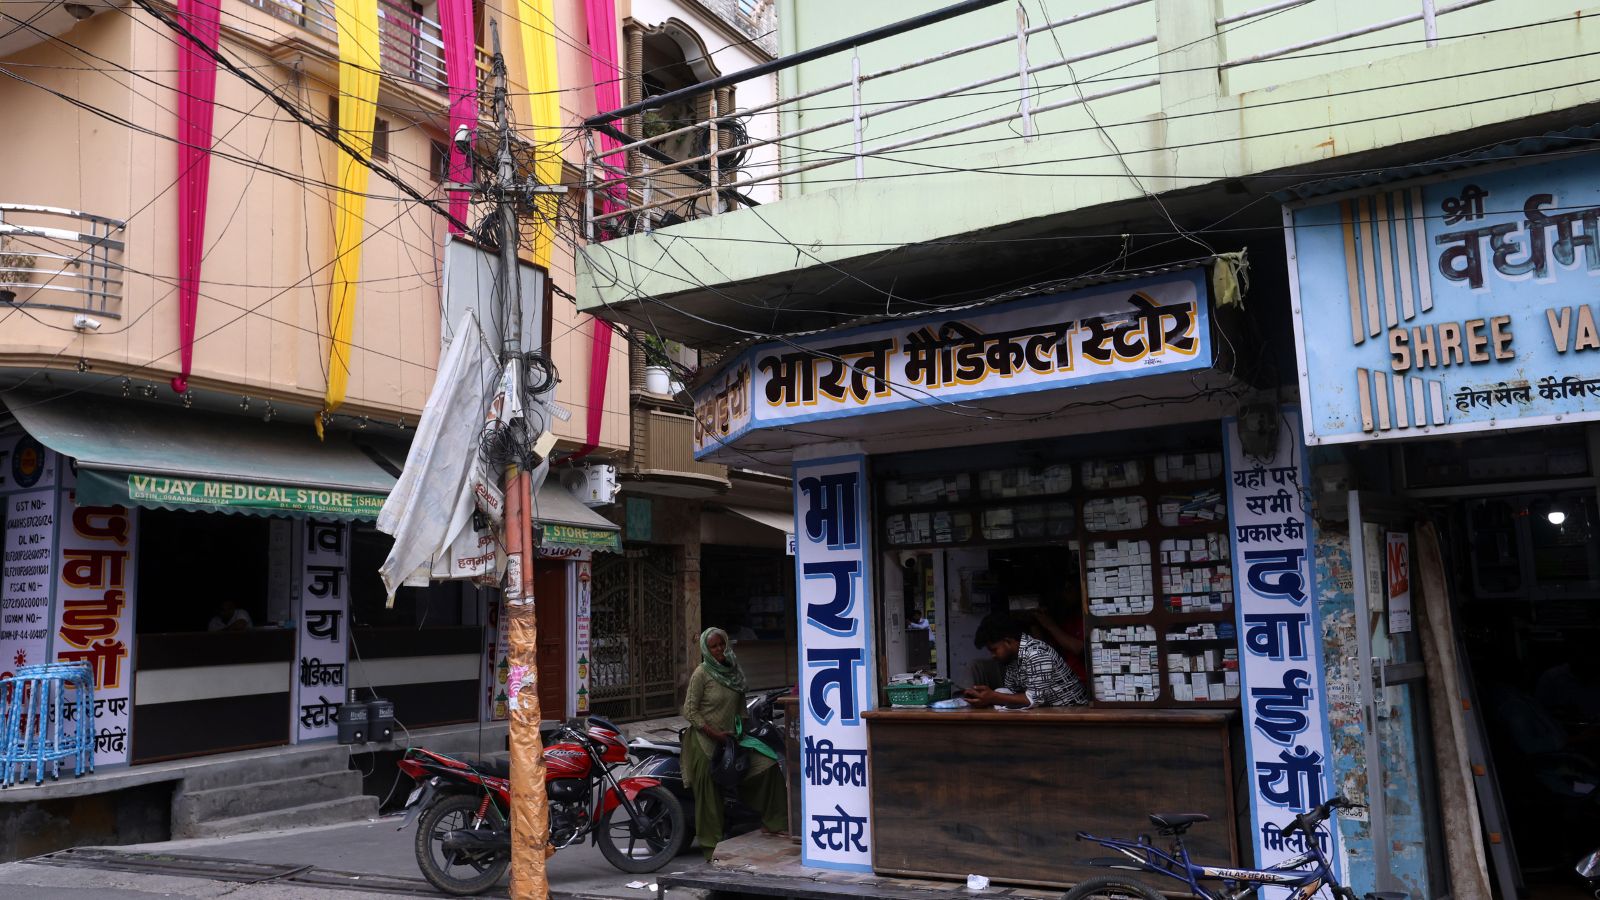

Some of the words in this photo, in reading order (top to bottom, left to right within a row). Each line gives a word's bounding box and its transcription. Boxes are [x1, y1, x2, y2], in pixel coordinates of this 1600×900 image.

[1441, 184, 1489, 226] श्री
[757, 337, 898, 406] भारत
[903, 320, 1078, 388] मैडिकल
[1081, 292, 1199, 360] स्टोर
[1388, 315, 1515, 371] SHREE
[1545, 304, 1600, 352] VA
[1269, 466, 1297, 486] पर
[133, 475, 196, 496] VIJAY
[203, 482, 290, 503] MEDICAL
[297, 488, 352, 507] STORE
[1245, 488, 1292, 515] सभी
[15, 501, 29, 512] GST
[19, 535, 28, 546] DL
[553, 526, 589, 539] STORE
[1236, 523, 1283, 543] प्रकार
[1283, 517, 1304, 540] की
[799, 471, 866, 726] भारत
[107, 697, 128, 716] पर
[804, 736, 867, 787] मैडिकल
[811, 804, 868, 853] स्टोर
